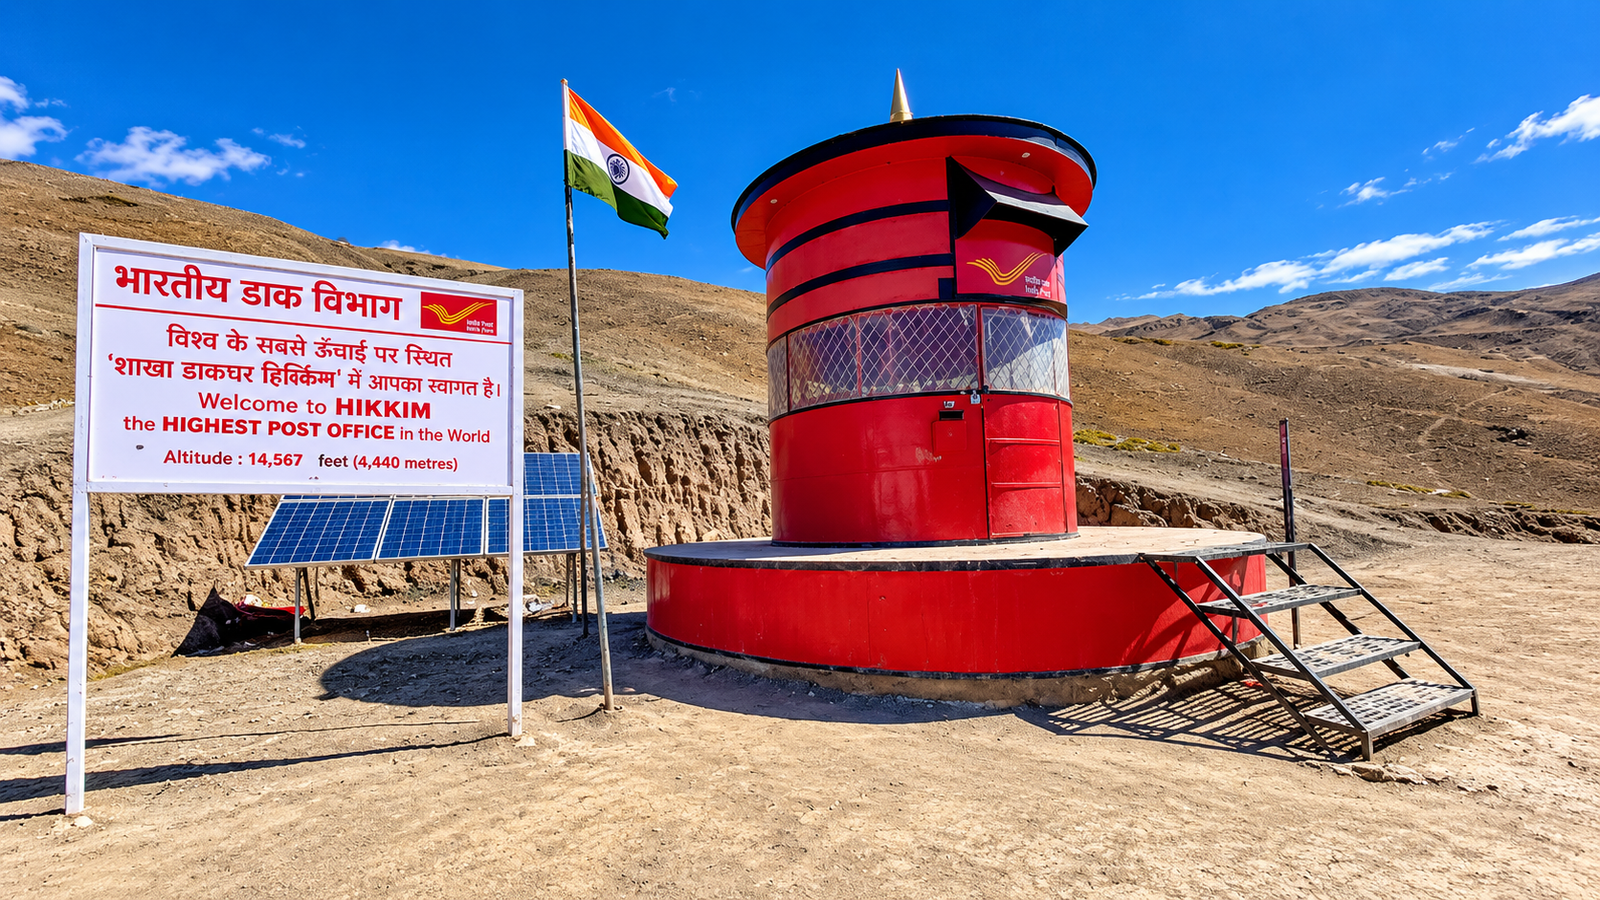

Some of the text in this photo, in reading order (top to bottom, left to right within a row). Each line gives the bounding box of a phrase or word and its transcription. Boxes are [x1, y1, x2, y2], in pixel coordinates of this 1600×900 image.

[115, 264, 404, 321] भारतीय डाक विभाग
[166, 322, 219, 351] विश्व
[226, 328, 249, 352] के
[256, 333, 308, 357] सबसे
[373, 346, 400, 364] पर
[405, 343, 454, 368] स्थित
[181, 361, 256, 383] डाकघर
[347, 367, 363, 390] में
[368, 374, 424, 393] आपका
[427, 378, 479, 397] स्वागत
[198, 391, 431, 420] Welcome to HIKKIM
[123, 415, 490, 444] the HIGHEST POST OFFICE in the World
[163, 449, 233, 466] Altitude
[248, 452, 304, 469] 14,567
[318, 454, 348, 468] feet
[353, 455, 400, 471] (4,440
[404, 457, 458, 472] metres)
